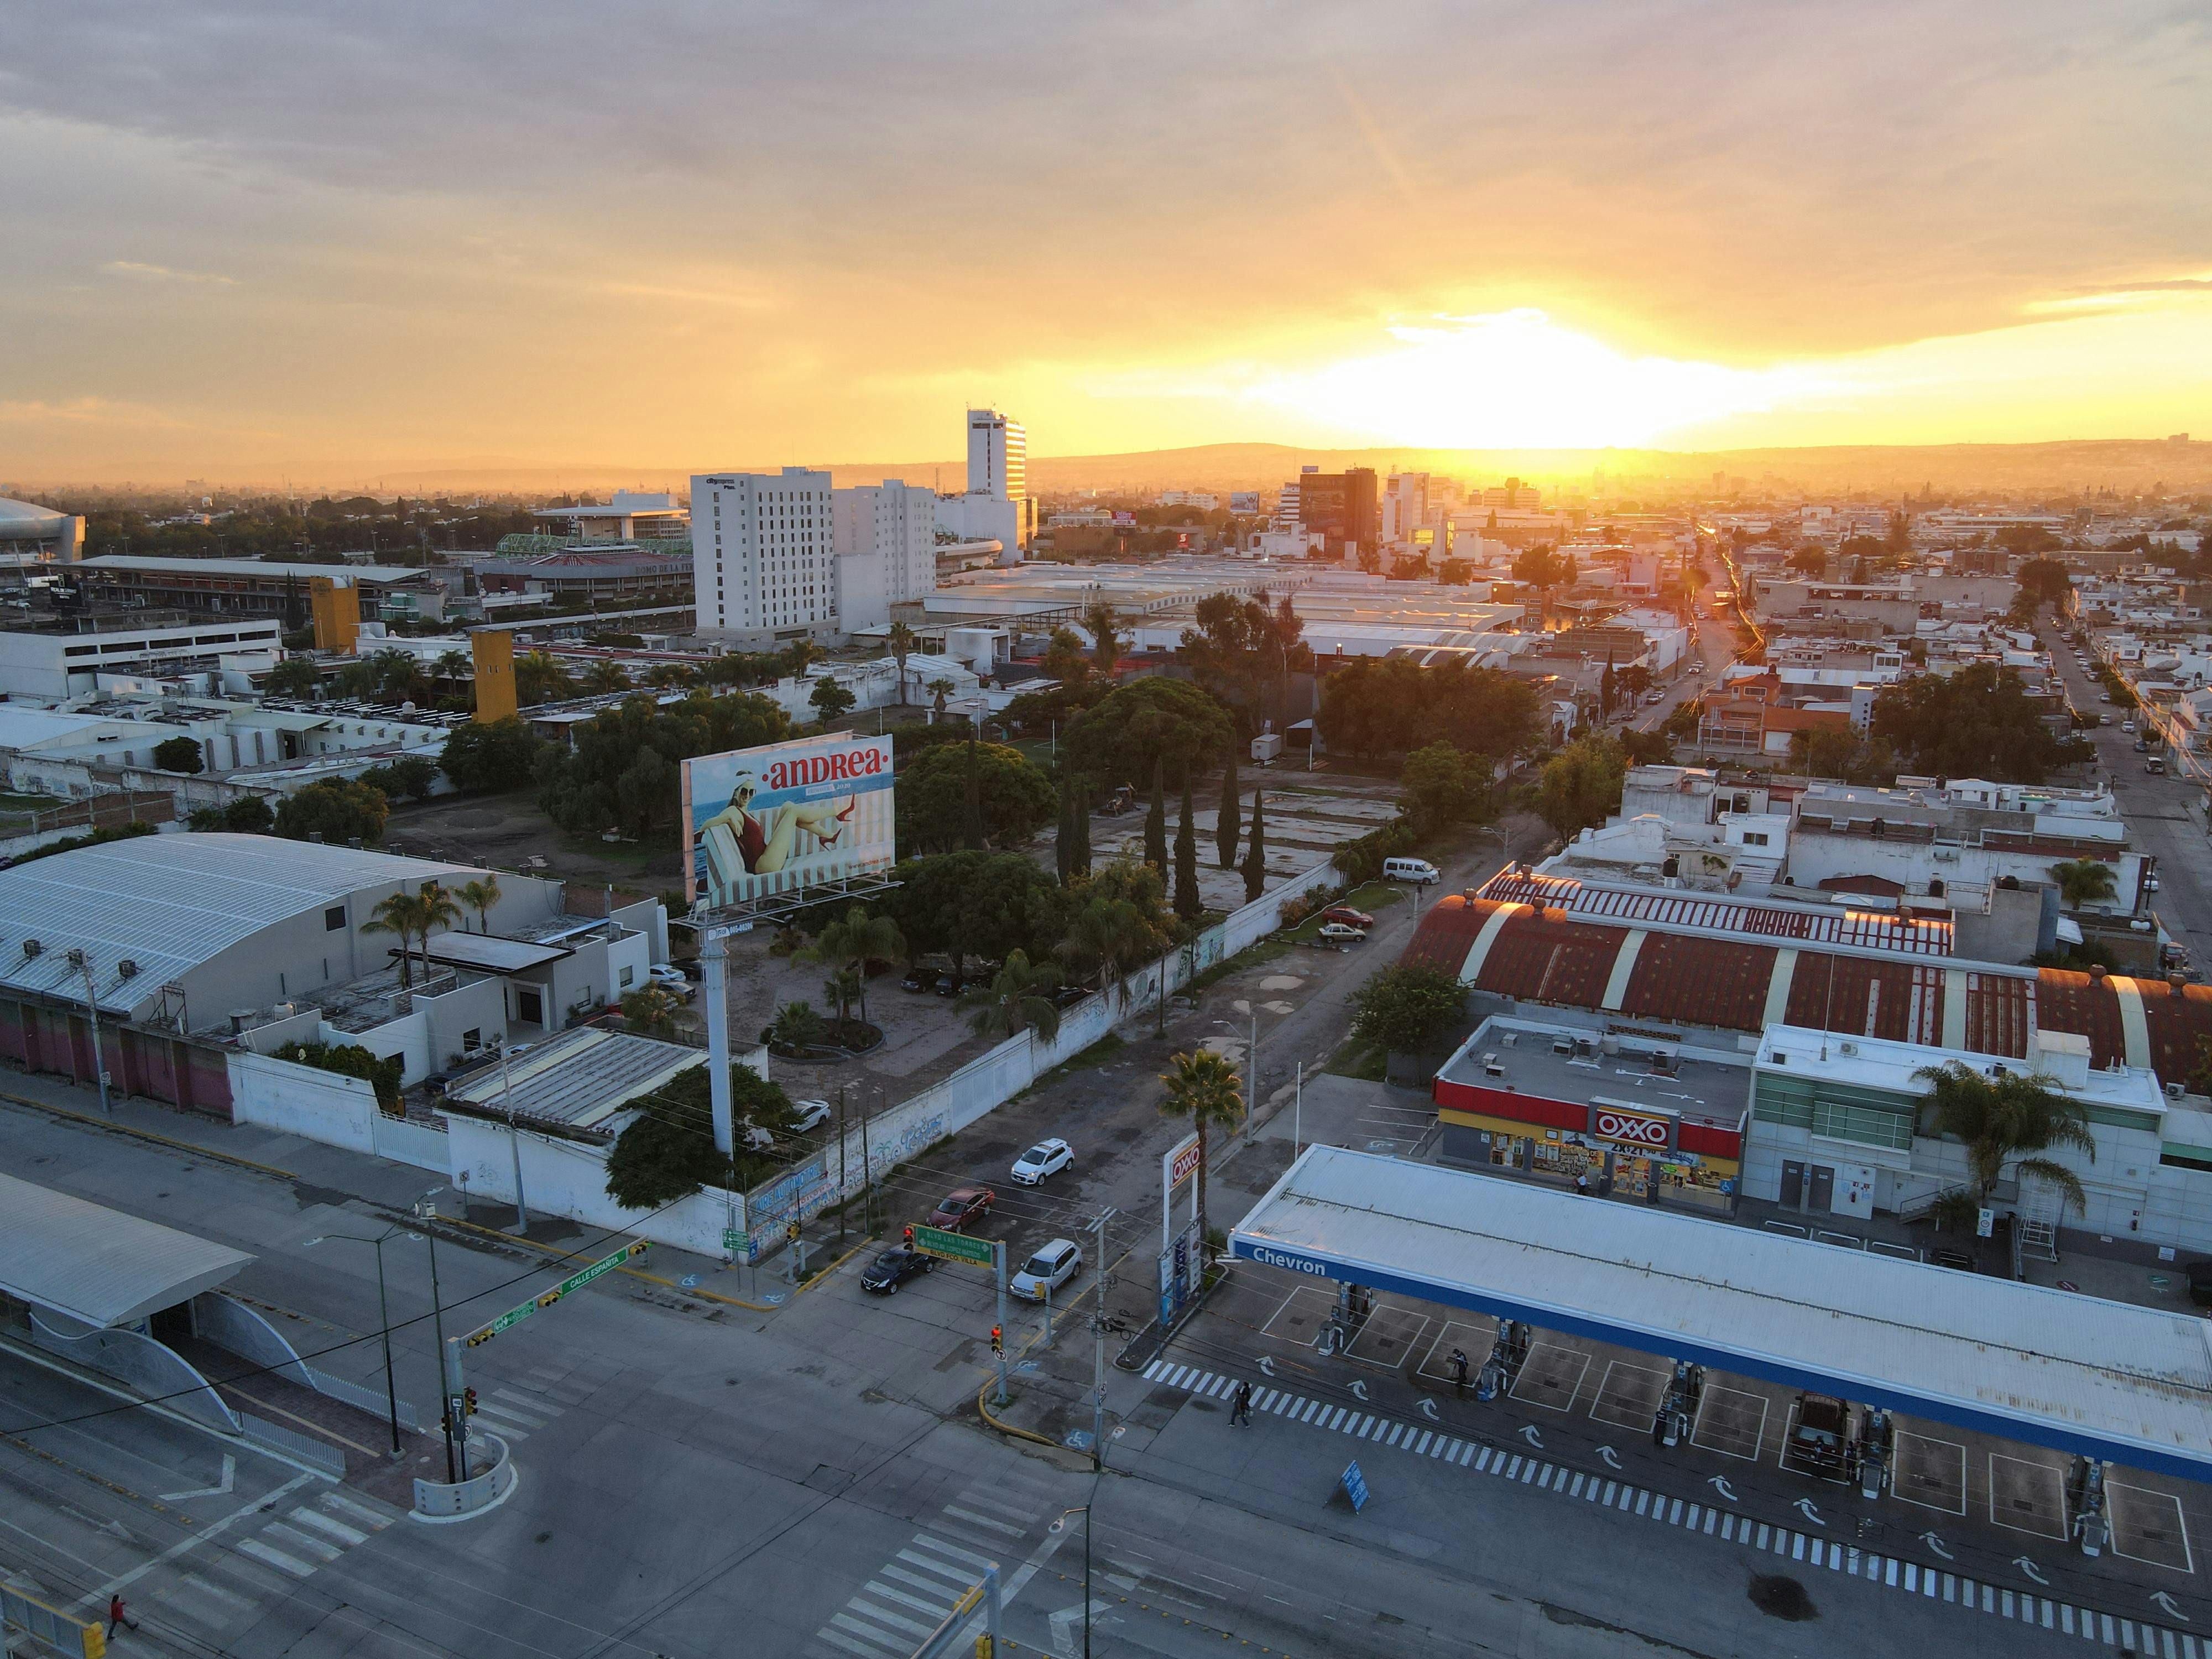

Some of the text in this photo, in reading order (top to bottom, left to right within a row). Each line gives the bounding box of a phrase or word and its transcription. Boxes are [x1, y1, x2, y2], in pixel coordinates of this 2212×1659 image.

[659, 564, 669, 572] DE
[670, 564, 679, 572] LA
[836, 782, 851, 790] 2020
[1599, 1115, 1666, 1142] OXXO
[1173, 1147, 1199, 1180] OXXO
[756, 1190, 774, 1211] AIRE
[774, 1159, 822, 1204] AUTOMOTRIZ
[926, 1231, 981, 1250] BLVD LAS TORRES
[930, 1249, 945, 1258] BLVD
[961, 1257, 978, 1266] VILLA
[1253, 1247, 1326, 1276] Chevron
[570, 1256, 619, 1288] CALLE ESPAÑITA
